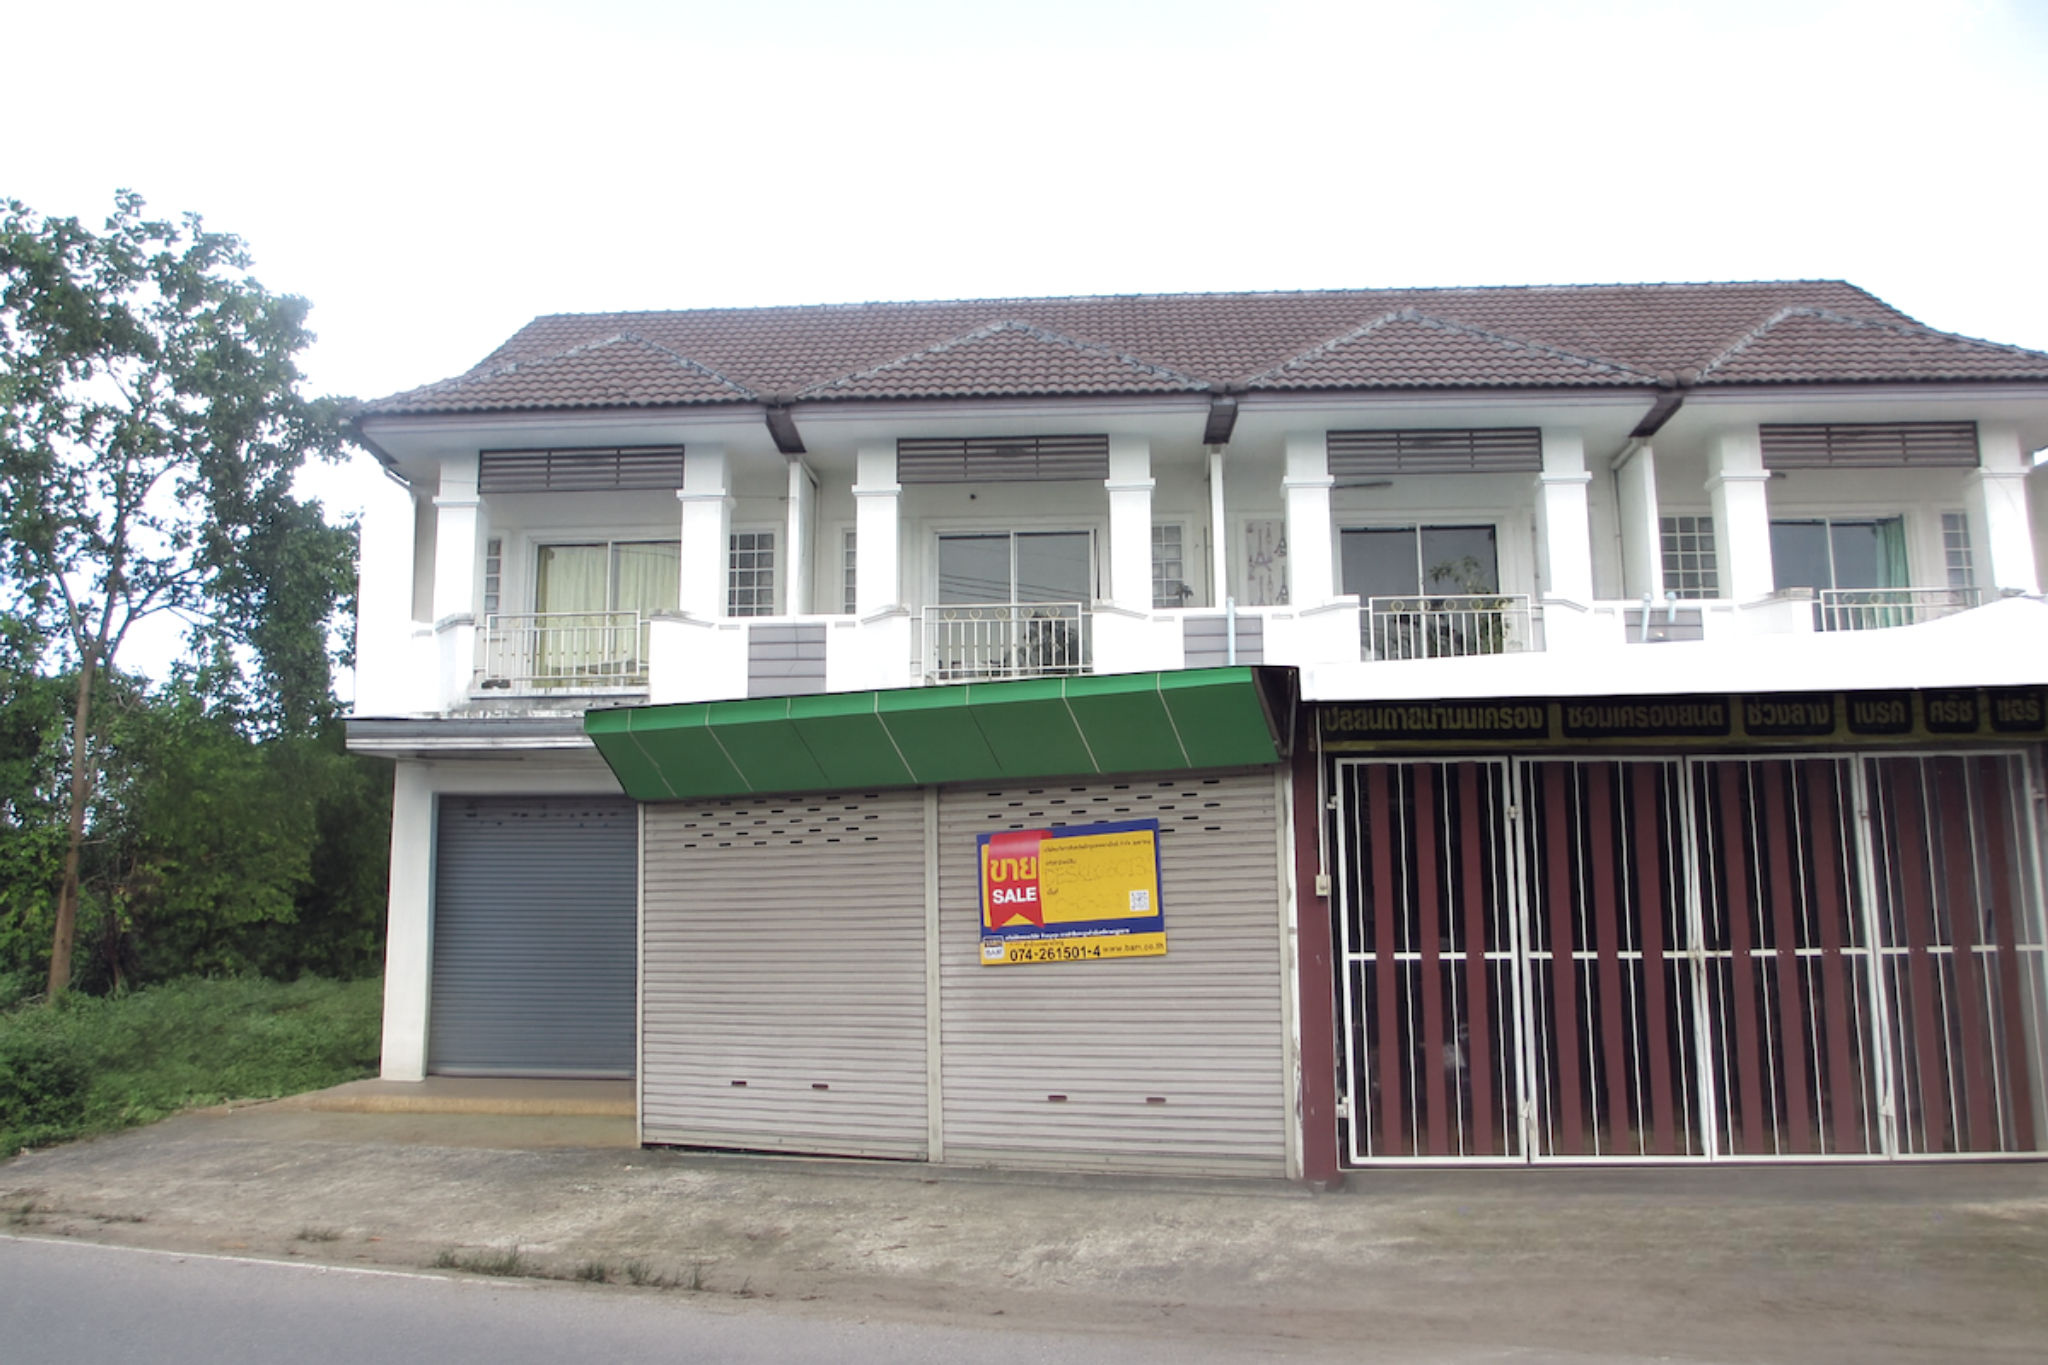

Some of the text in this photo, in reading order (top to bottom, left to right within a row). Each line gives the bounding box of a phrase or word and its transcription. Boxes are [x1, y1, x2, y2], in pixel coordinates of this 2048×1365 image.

[990, 856, 1037, 882] ขาย
[992, 886, 1037, 904] SALE
[1010, 945, 1101, 962] 074-261501-4
